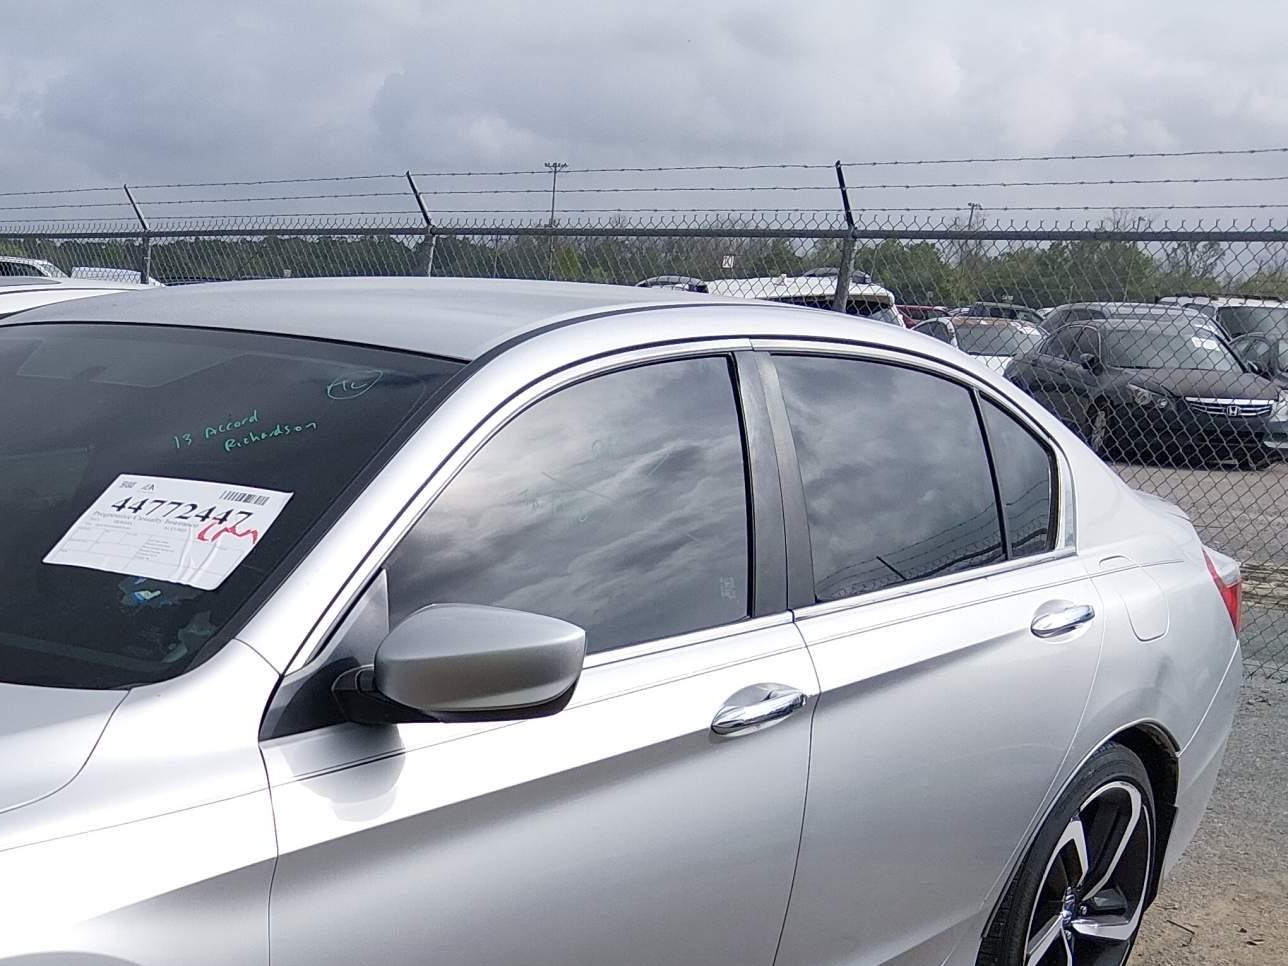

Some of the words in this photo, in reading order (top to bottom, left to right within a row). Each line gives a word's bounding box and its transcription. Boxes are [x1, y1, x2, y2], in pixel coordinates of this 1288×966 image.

[173, 433, 193, 449] 13
[204, 409, 259, 439] Accord
[224, 421, 318, 452] Richardson
[111, 496, 254, 528] 44772447
